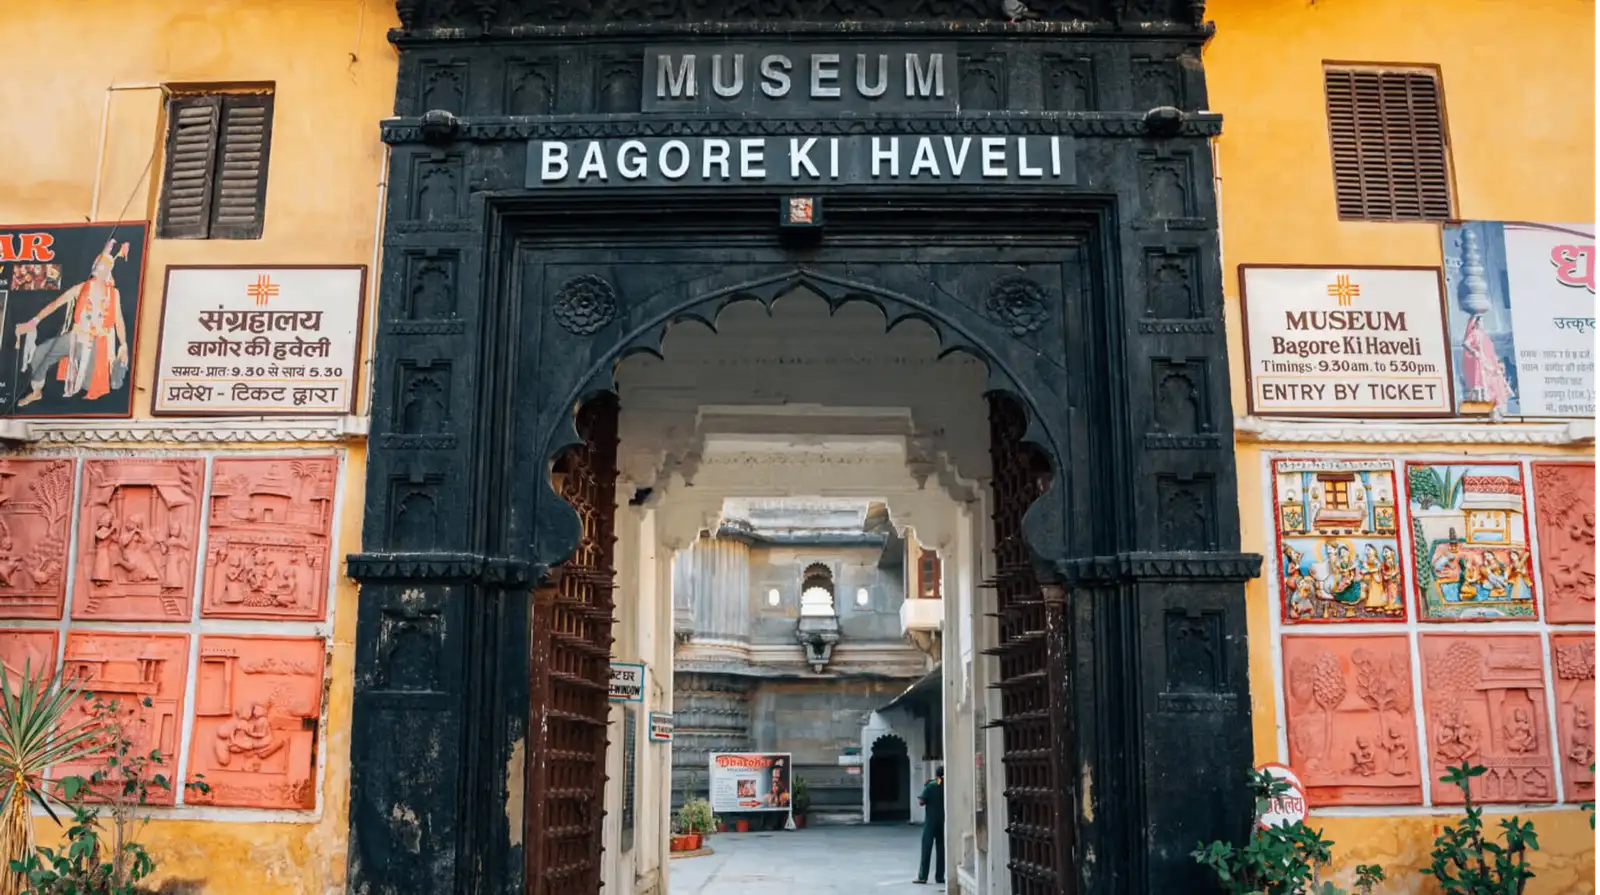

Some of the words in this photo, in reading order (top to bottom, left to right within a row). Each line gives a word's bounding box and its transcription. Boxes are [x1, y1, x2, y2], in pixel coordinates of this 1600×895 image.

[656, 53, 945, 98] MUSEUM
[541, 138, 767, 181] BAGORE
[789, 137, 839, 179] KI
[871, 136, 1062, 178] HAVELI
[199, 304, 323, 334] संग्रहालय
[1285, 310, 1408, 331] MUSEUM
[187, 335, 242, 357] बागोर
[245, 335, 271, 356] की
[273, 335, 331, 361] हवेली
[1271, 336, 1341, 358] Bagore
[1342, 336, 1363, 355] Ki
[1365, 336, 1422, 356] Haveli
[268, 362, 279, 377] से
[282, 364, 306, 378] सायं
[309, 367, 343, 378] 5.30
[1374, 360, 1386, 372] to
[167, 382, 213, 402] प्रवेश
[232, 382, 287, 401] टिकट
[293, 387, 339, 406] द्वारा
[1262, 384, 1326, 401] ENTRY
[1334, 384, 1359, 401] BY
[1367, 384, 1437, 401] TICKET
